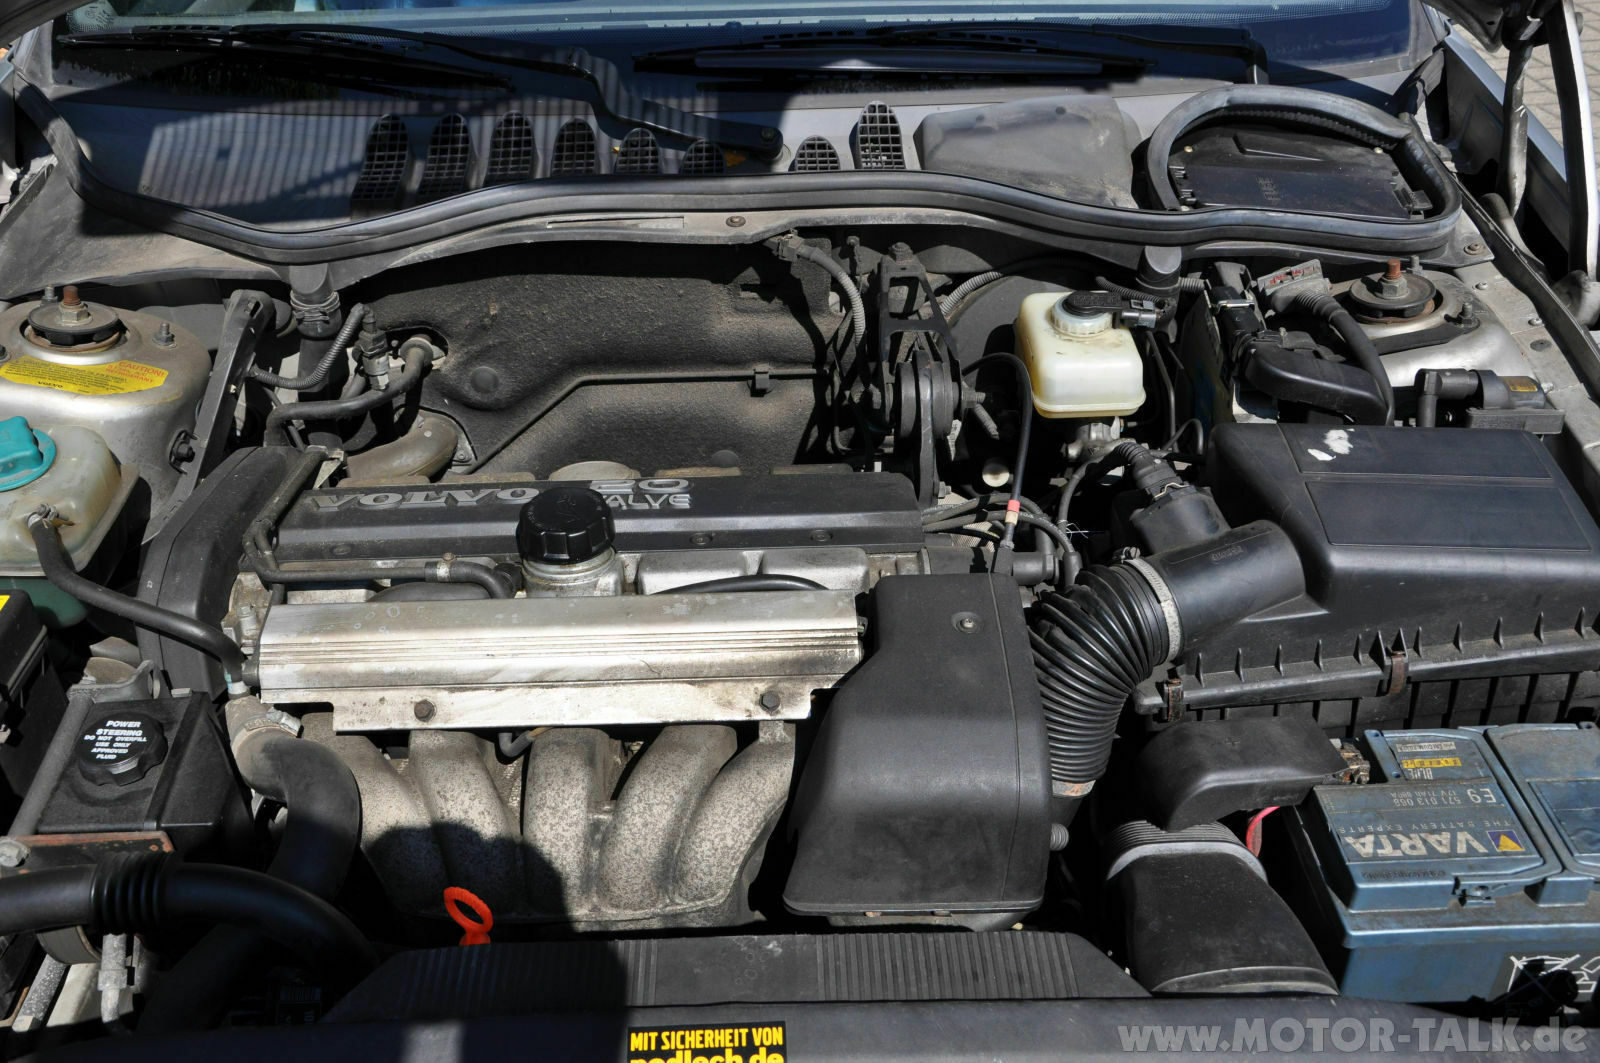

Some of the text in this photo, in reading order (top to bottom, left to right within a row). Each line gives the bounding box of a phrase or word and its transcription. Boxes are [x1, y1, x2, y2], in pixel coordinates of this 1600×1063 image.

[590, 479, 689, 494] 20
[311, 487, 540, 512] VOLVO
[603, 494, 691, 510] ALVE
[96, 728, 143, 736] STEERING
[1467, 788, 1497, 804] E9
[1338, 824, 1403, 834] EXPERTS
[1412, 820, 1475, 830] BATTERY
[1344, 831, 1489, 858] VARTA
[630, 1026, 783, 1052] MIT SICHERHEIT VON
